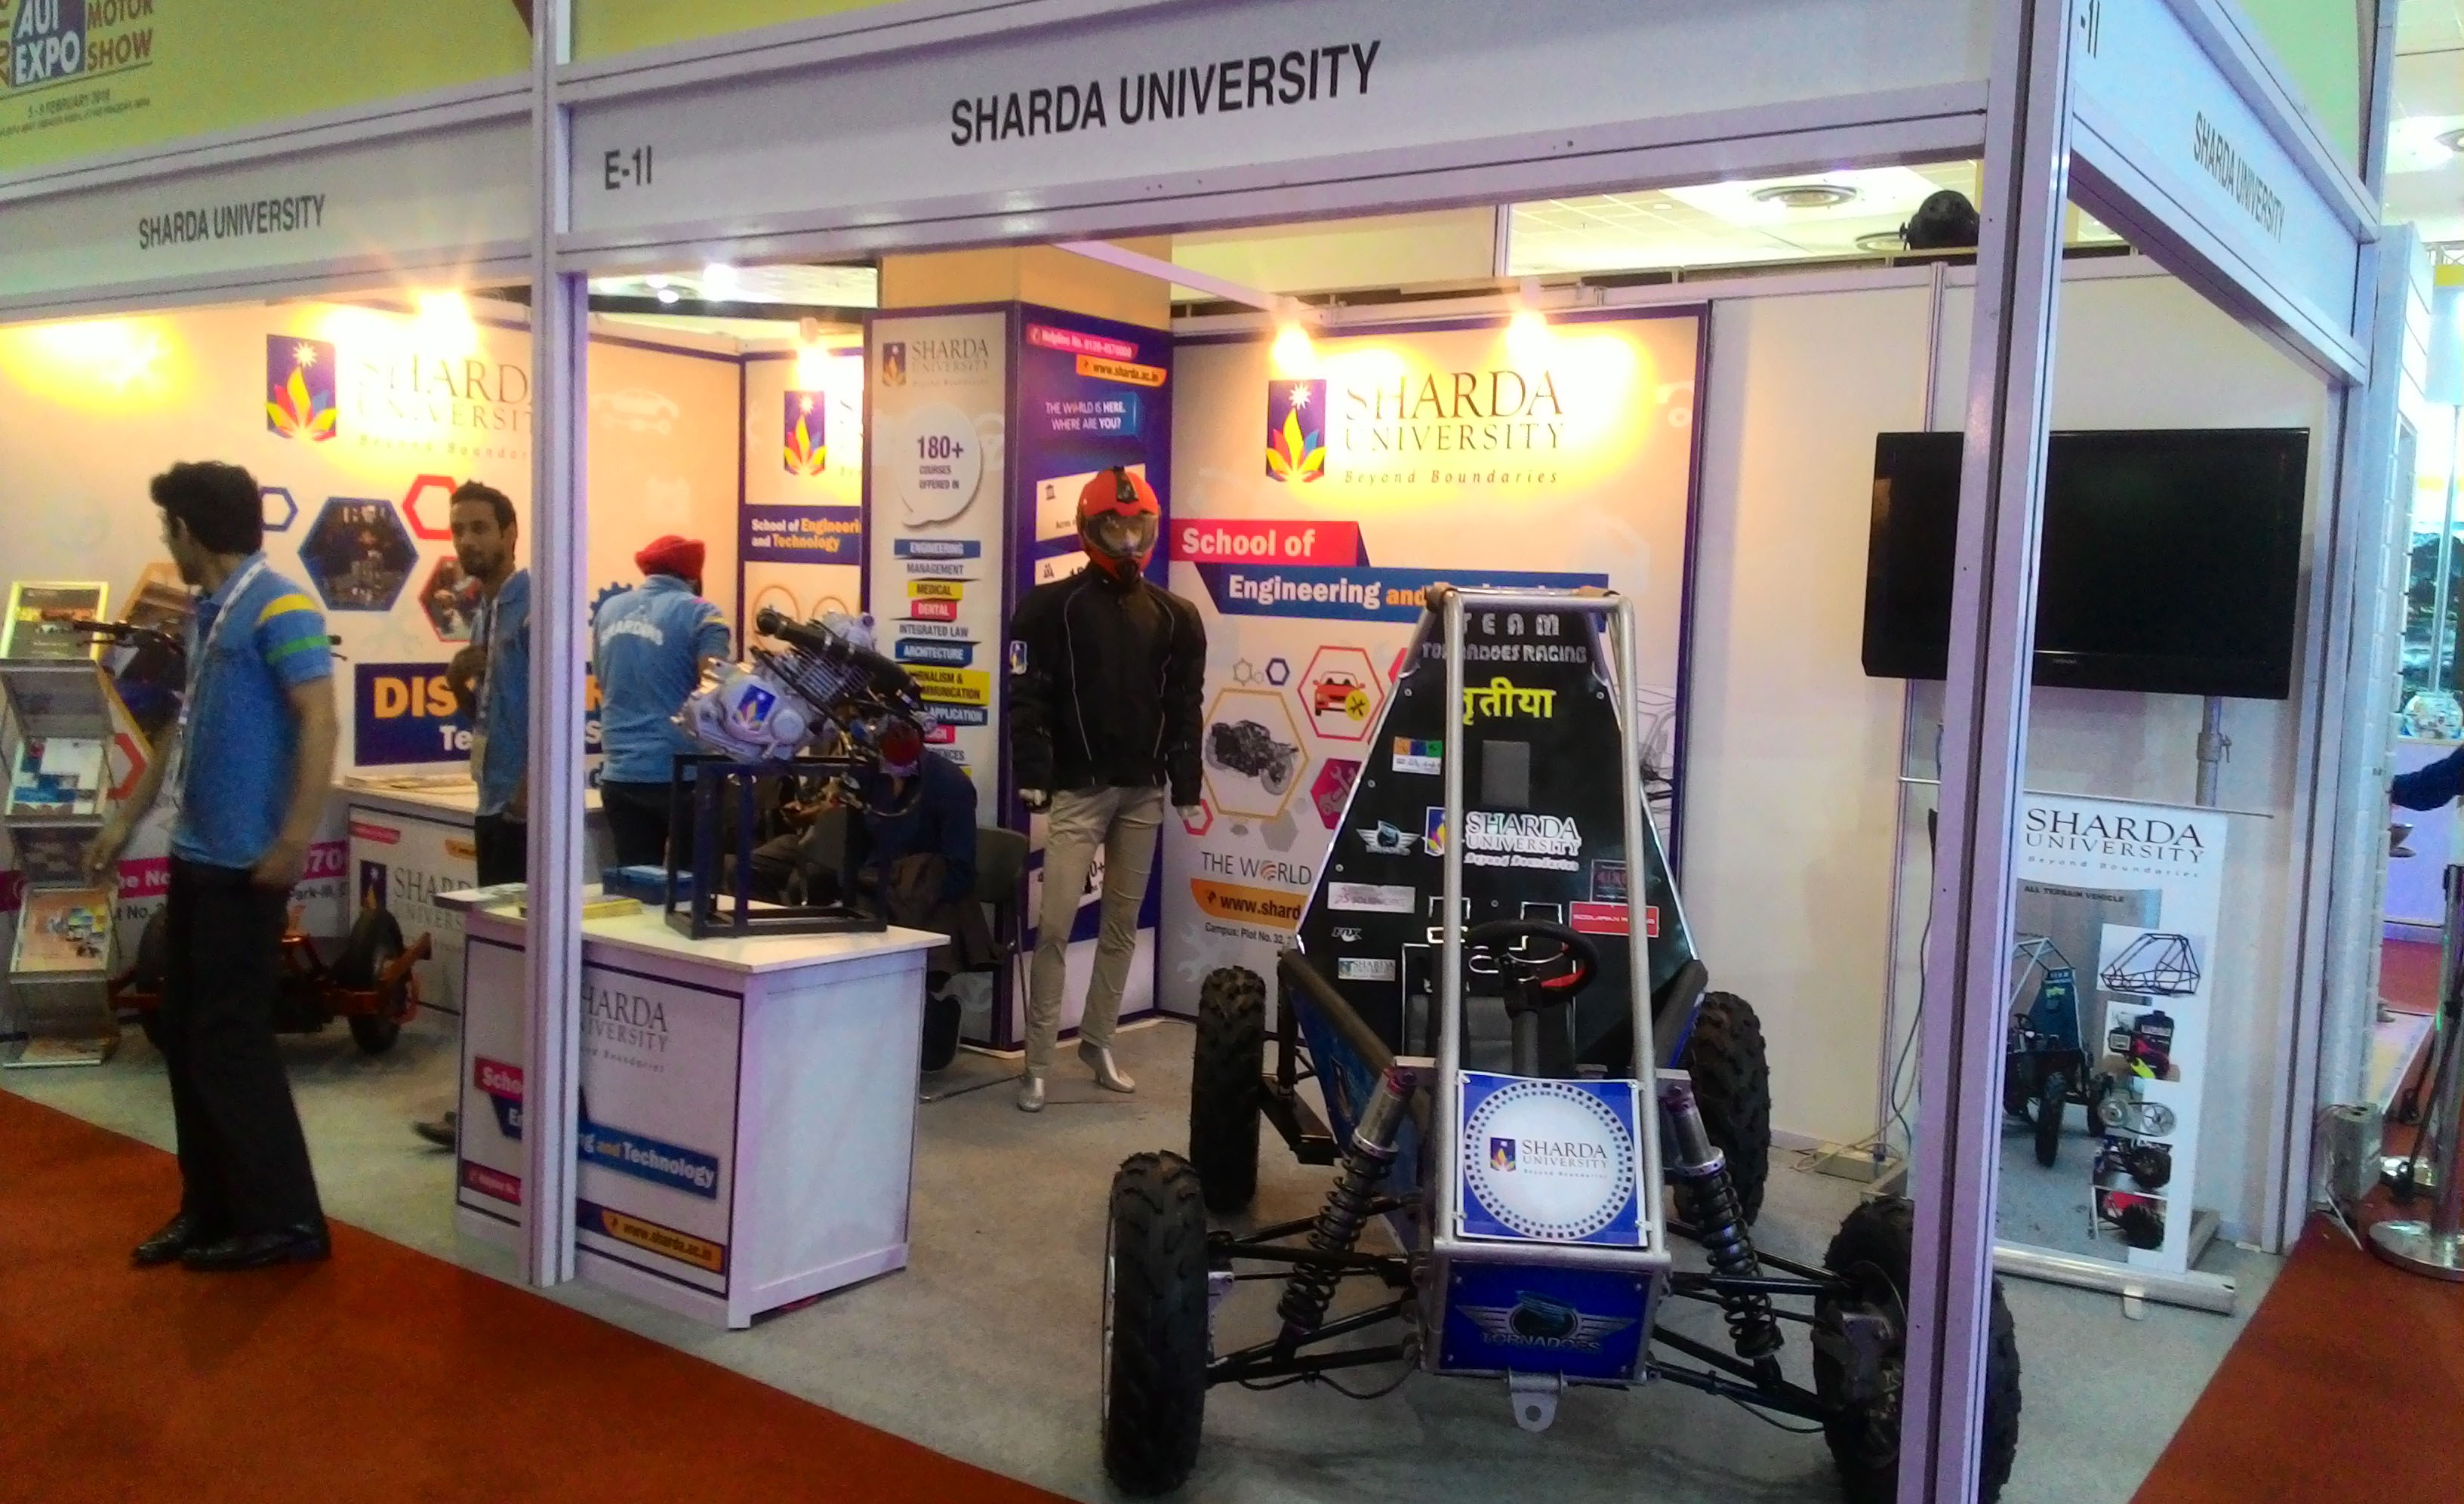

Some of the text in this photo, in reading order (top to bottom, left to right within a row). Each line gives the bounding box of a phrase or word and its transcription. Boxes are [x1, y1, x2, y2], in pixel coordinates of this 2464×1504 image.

[15, 30, 81, 85] EXPO
[87, 27, 154, 71] SHOW
[951, 40, 1381, 146] SHARDA UNIVERSITY
[2194, 111, 2285, 243] SHARDA UNIVERSITY
[139, 194, 325, 249] SHARDA UNIVERSITY
[911, 338, 990, 360] SHARDA
[912, 359, 989, 375] UNIVERSITY
[1346, 370, 1563, 421] SHARDA
[1046, 401, 1126, 415] THE WORLD IS HERE.
[1052, 417, 1122, 431] WHERE ARE YOU?
[1346, 423, 1564, 452] UNIVERSITY
[916, 435, 964, 460] 180+
[919, 464, 952, 476] COURSES
[1344, 469, 1558, 487] Beyond Boundaries
[919, 479, 960, 490] OFFERED IN
[752, 517, 861, 534] School of Engineeri
[752, 534, 840, 553] and Technology
[910, 541, 964, 555] ENGINEERING
[1182, 527, 1316, 557] School of
[907, 562, 964, 575] MANAGEMENT
[916, 582, 952, 596] MEDICAL
[1229, 574, 1428, 610] Engineering and
[917, 603, 950, 617] DENTAL
[899, 623, 969, 638] INTEGRATED LAW
[904, 644, 964, 660] ARCHITECTURE
[1523, 644, 1588, 663] RACING
[955, 673, 963, 684] &
[1466, 812, 1581, 840] SHARDA
[2025, 808, 2204, 848] SHARDA
[1465, 835, 1582, 856] UNIVERSITY
[2026, 832, 2204, 864] UNIVERSITY
[1202, 852, 1312, 885] THE WORLD
[2028, 855, 2198, 878] Beyond Boundaries
[2024, 885, 2125, 903] ALL TERRAIN VEHICLE
[1241, 929, 1256, 940] Plot
[1258, 932, 1272, 943] No.
[581, 986, 667, 1033] HARDA
[1522, 1139, 1607, 1159] SHARDA
[623, 1141, 715, 1188] Technology
[1523, 1155, 1608, 1169] UNIVERSITY
[1481, 1332, 1602, 1351] TORNADOES
